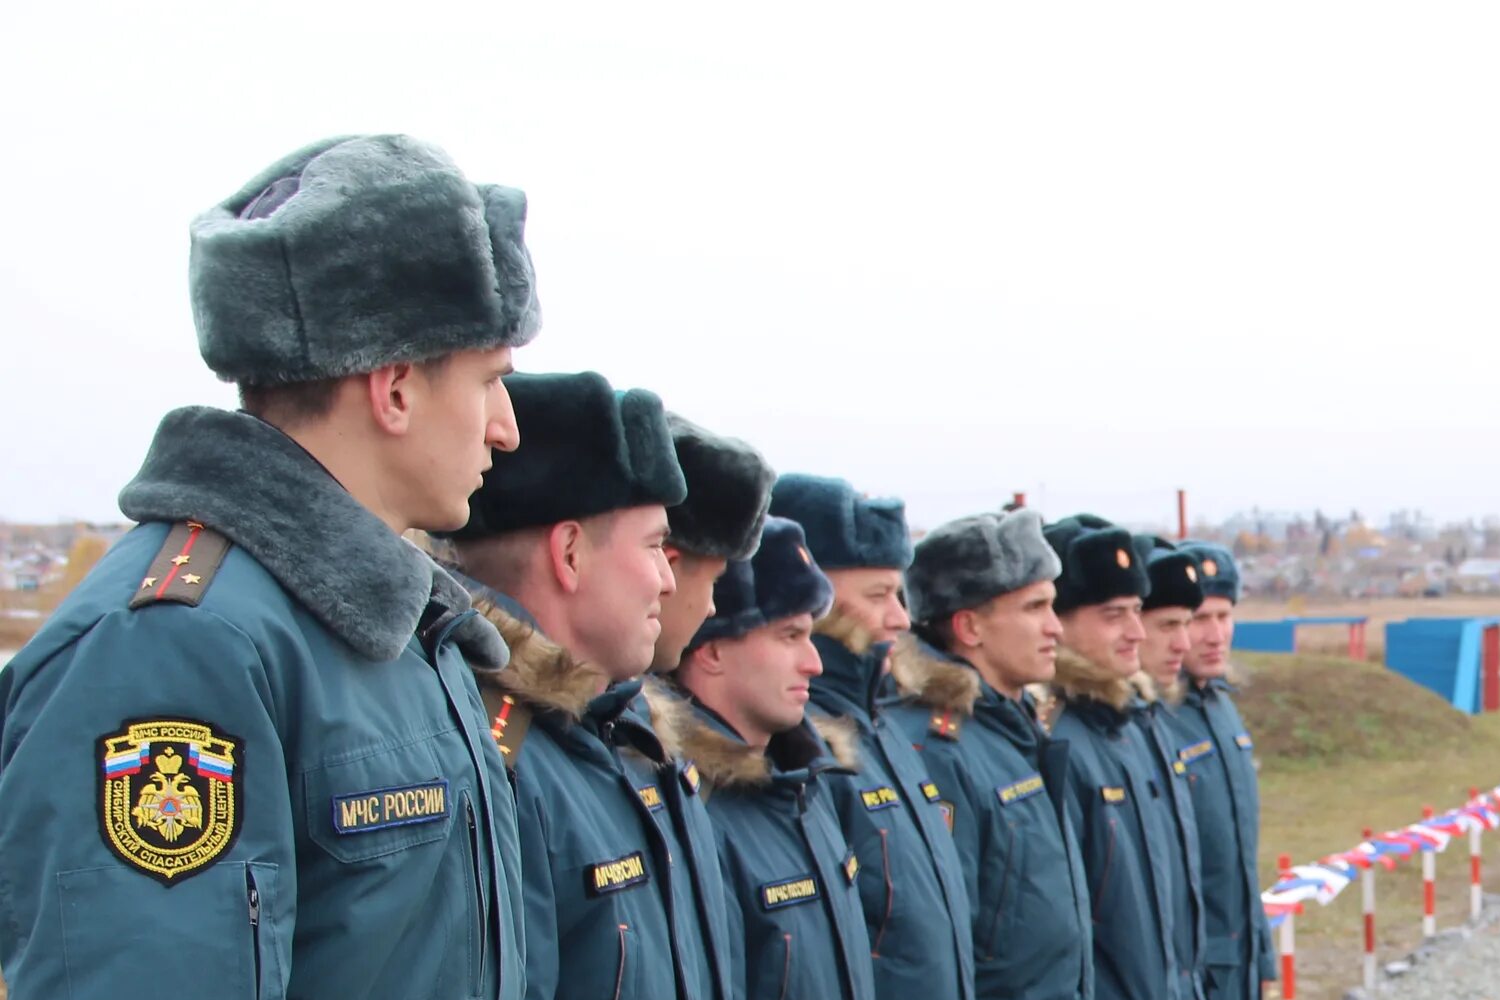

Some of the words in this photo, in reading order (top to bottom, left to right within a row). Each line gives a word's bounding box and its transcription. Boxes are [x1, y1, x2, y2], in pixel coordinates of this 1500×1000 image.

[135, 730, 159, 739] МЧС
[160, 728, 206, 741] РОССИИ
[112, 781, 137, 855] СИБИРСКИЙ
[139, 823, 228, 867] СПАСАТЕЛЬНЫЙ
[216, 780, 227, 820] ЦЕНТР
[342, 797, 380, 827] МЧС
[384, 787, 444, 820] РОССИИ
